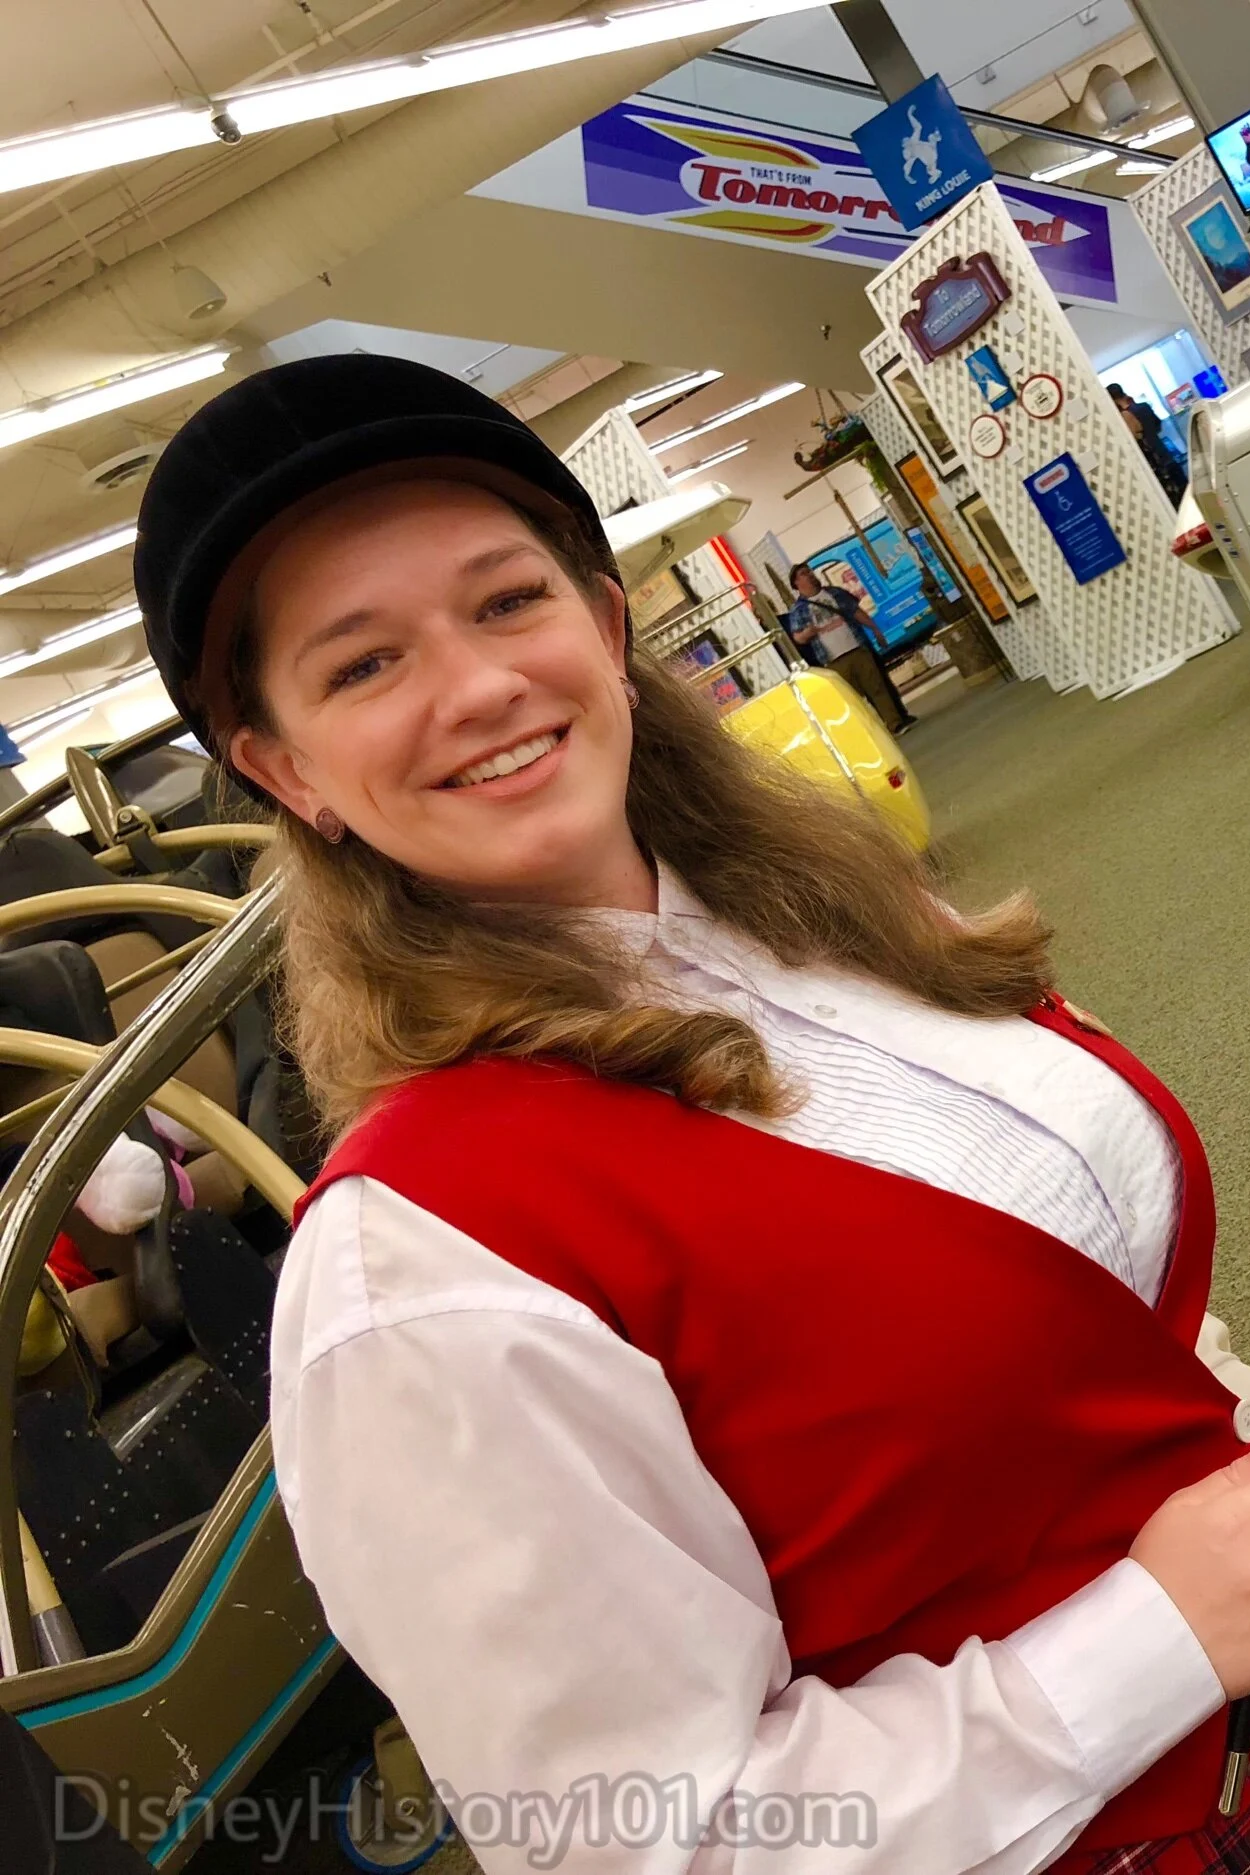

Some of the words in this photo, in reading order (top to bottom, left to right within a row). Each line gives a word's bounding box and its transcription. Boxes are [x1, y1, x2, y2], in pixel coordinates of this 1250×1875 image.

[750, 166, 783, 182] THAT'S
[785, 172, 812, 187] FROM
[915, 187, 943, 212] KING
[941, 169, 971, 196] LOUIE
[923, 283, 982, 338] Tomorrowland
